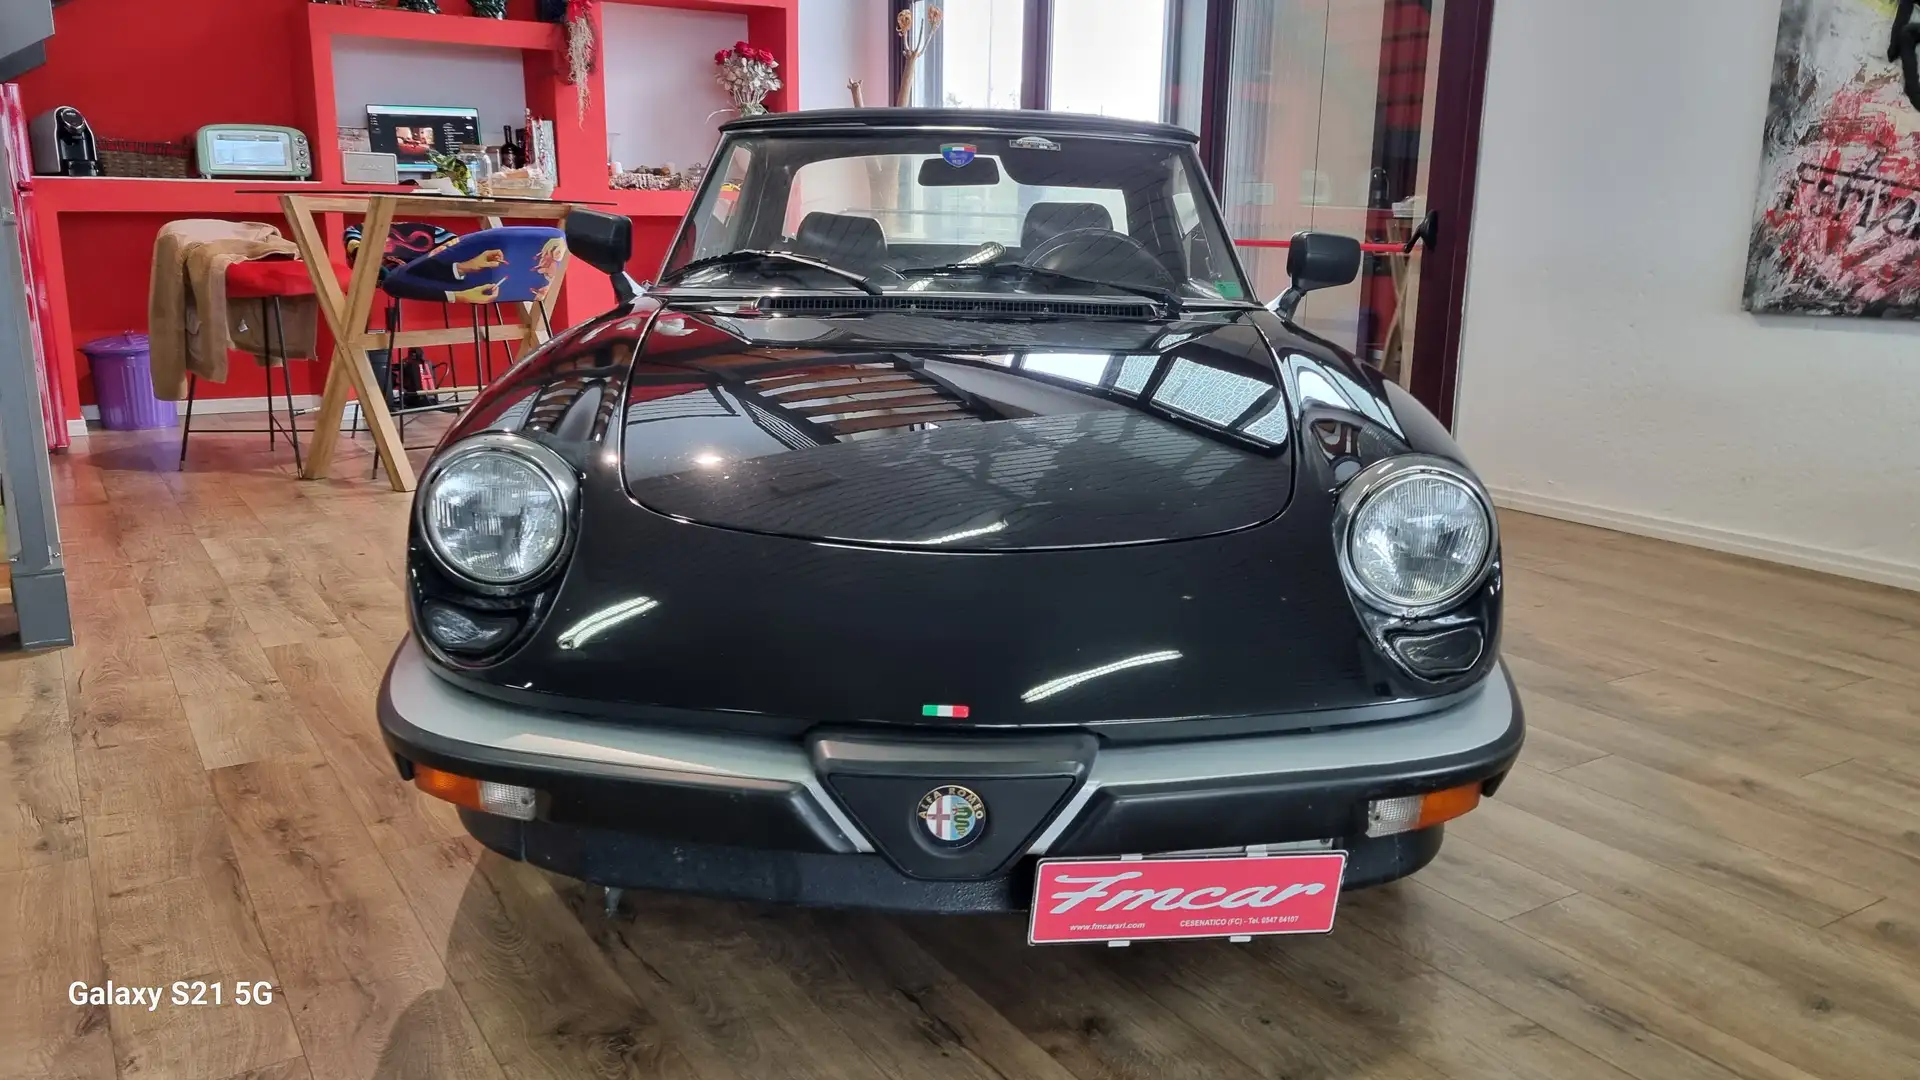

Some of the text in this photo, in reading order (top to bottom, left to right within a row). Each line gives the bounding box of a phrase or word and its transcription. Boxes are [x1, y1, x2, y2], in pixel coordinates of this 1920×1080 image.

[918, 787, 984, 819] ALFA ROMEO
[1050, 871, 1326, 914] Fmcar
[1070, 922, 1145, 931] www.fmcarsrl.com
[1180, 918, 1226, 927] CESENATICO
[1228, 917, 1243, 927] (FC)
